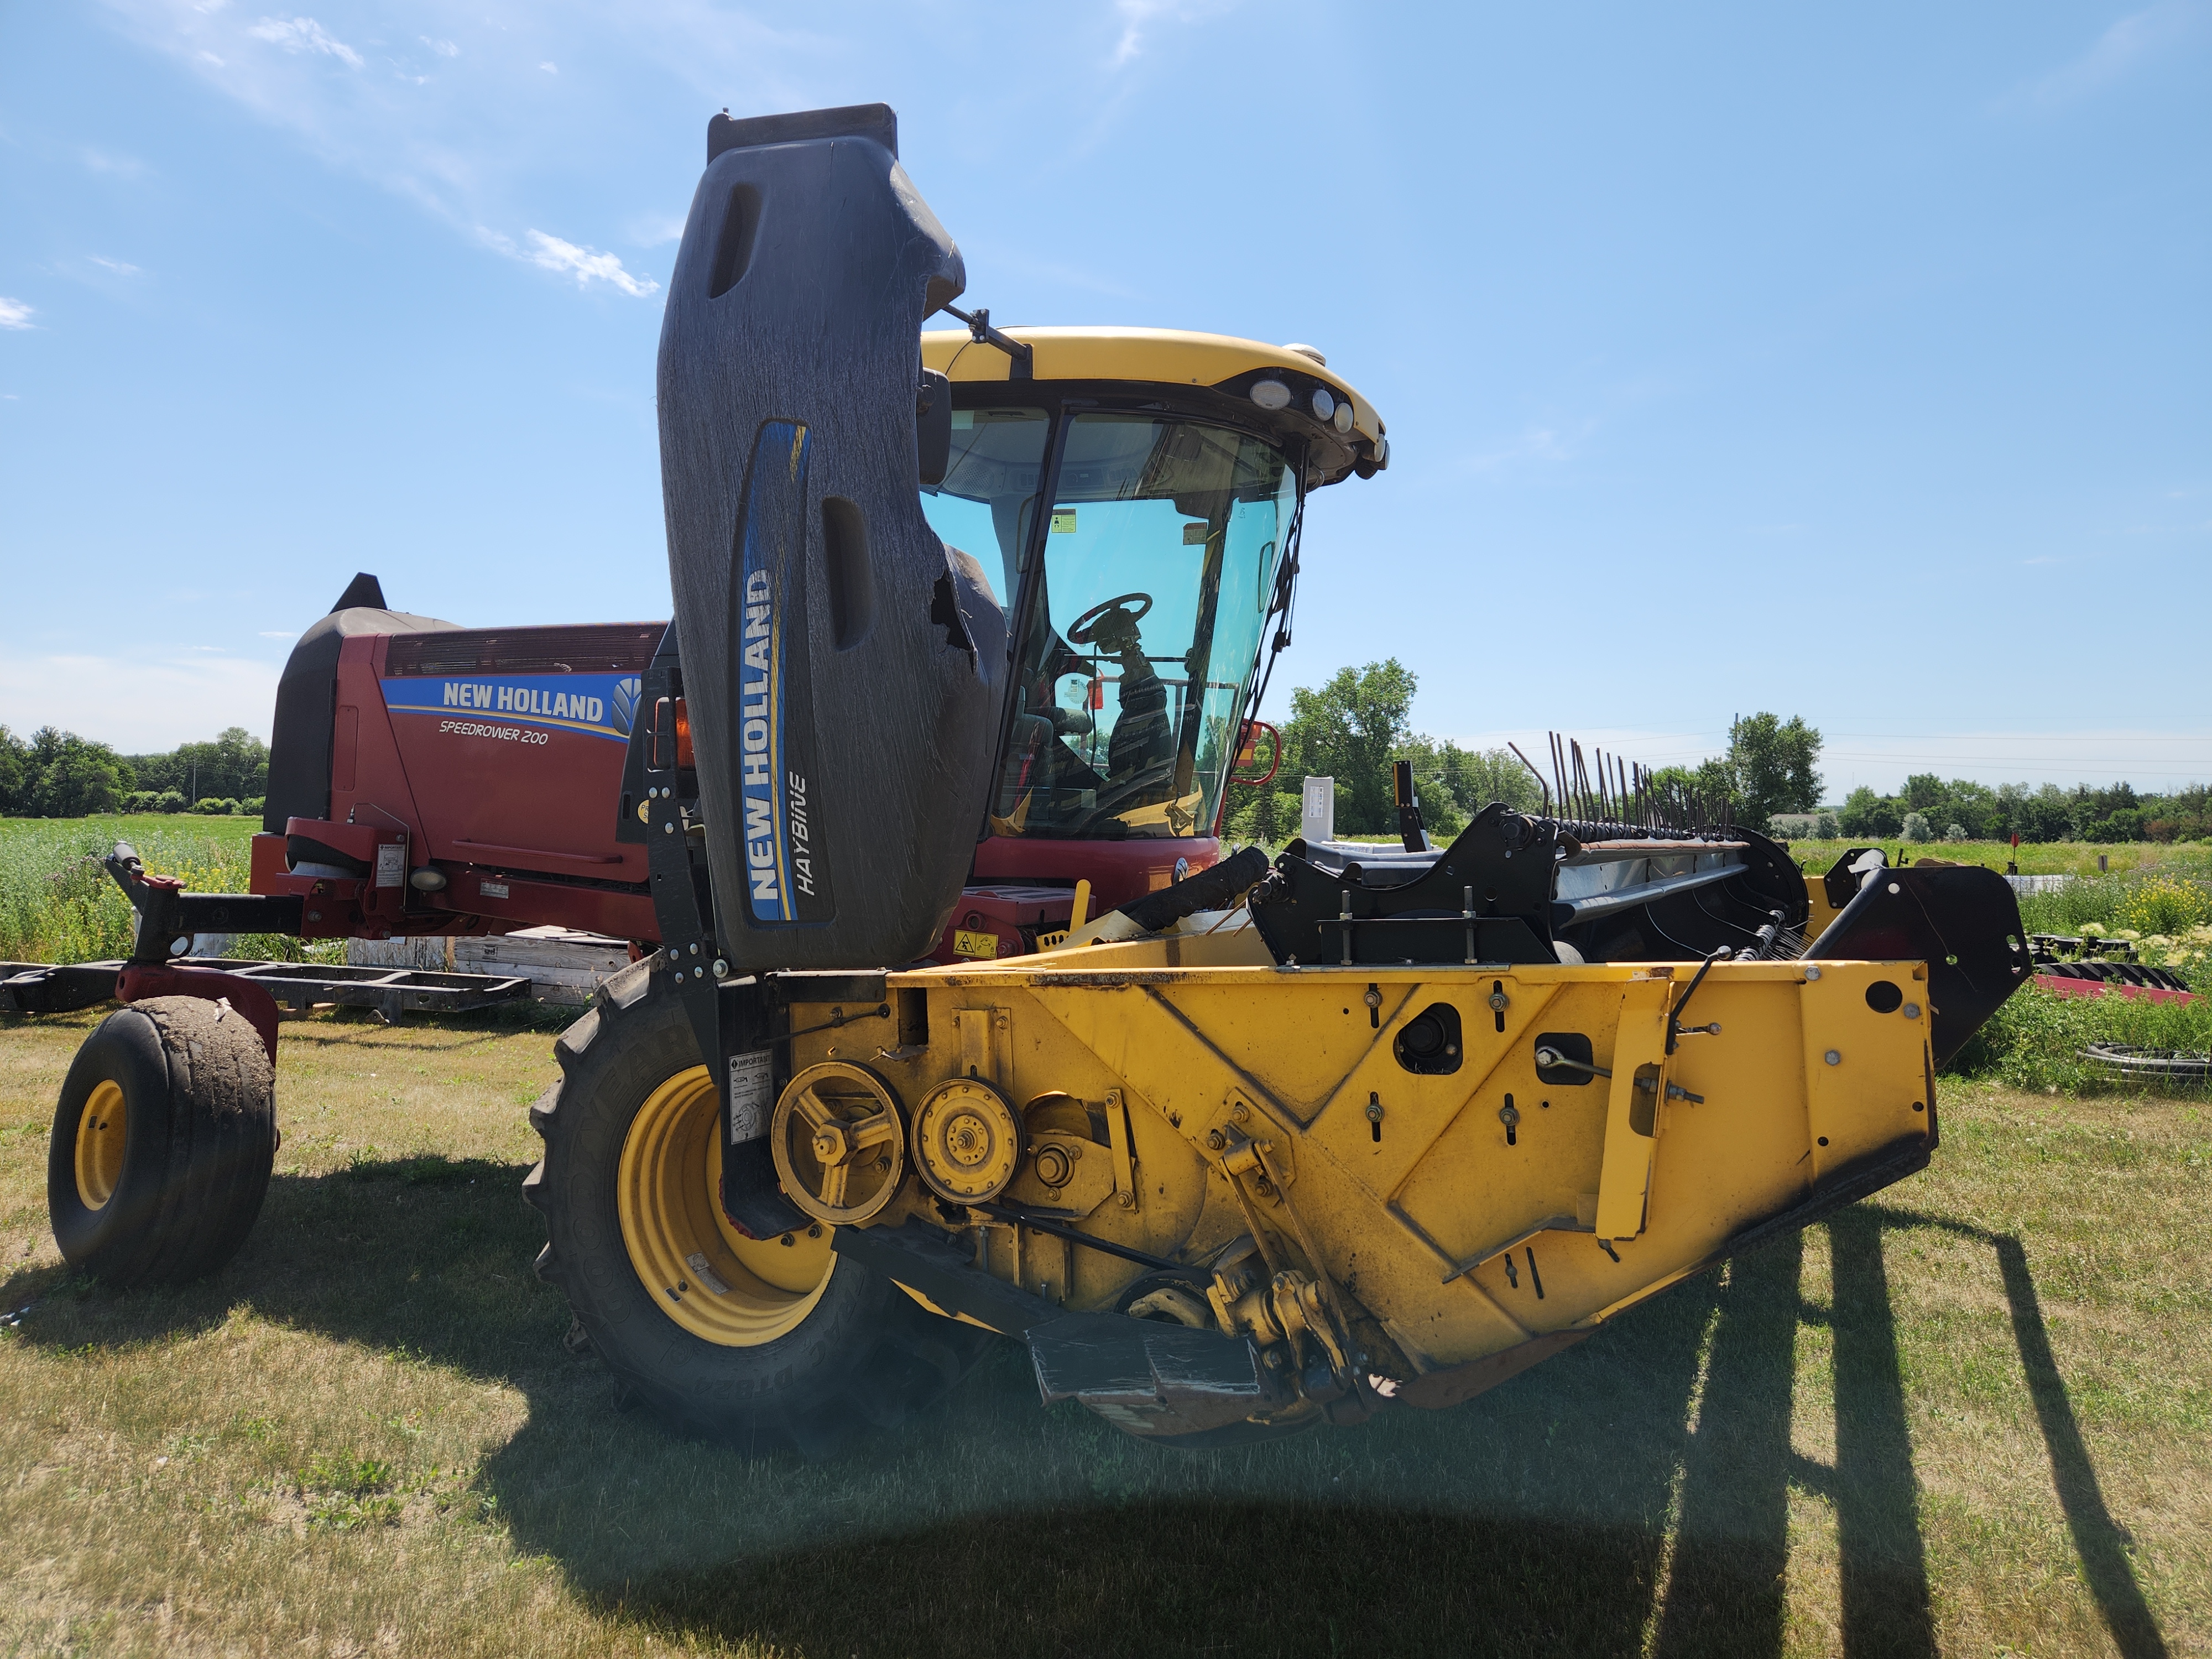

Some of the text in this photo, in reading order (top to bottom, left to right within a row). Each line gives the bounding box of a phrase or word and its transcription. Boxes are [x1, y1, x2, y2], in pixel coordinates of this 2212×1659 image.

[443, 682, 603, 723] NEW HOLLAND
[439, 721, 549, 745] SPEEDROWER 200
[744, 569, 779, 900] NEW HOLLAND
[790, 772, 815, 896] HAYBINE
[739, 1056, 770, 1067] IMPORTANT
[571, 1024, 692, 1326] GOODYEAR
[693, 1363, 794, 1401] DT824
